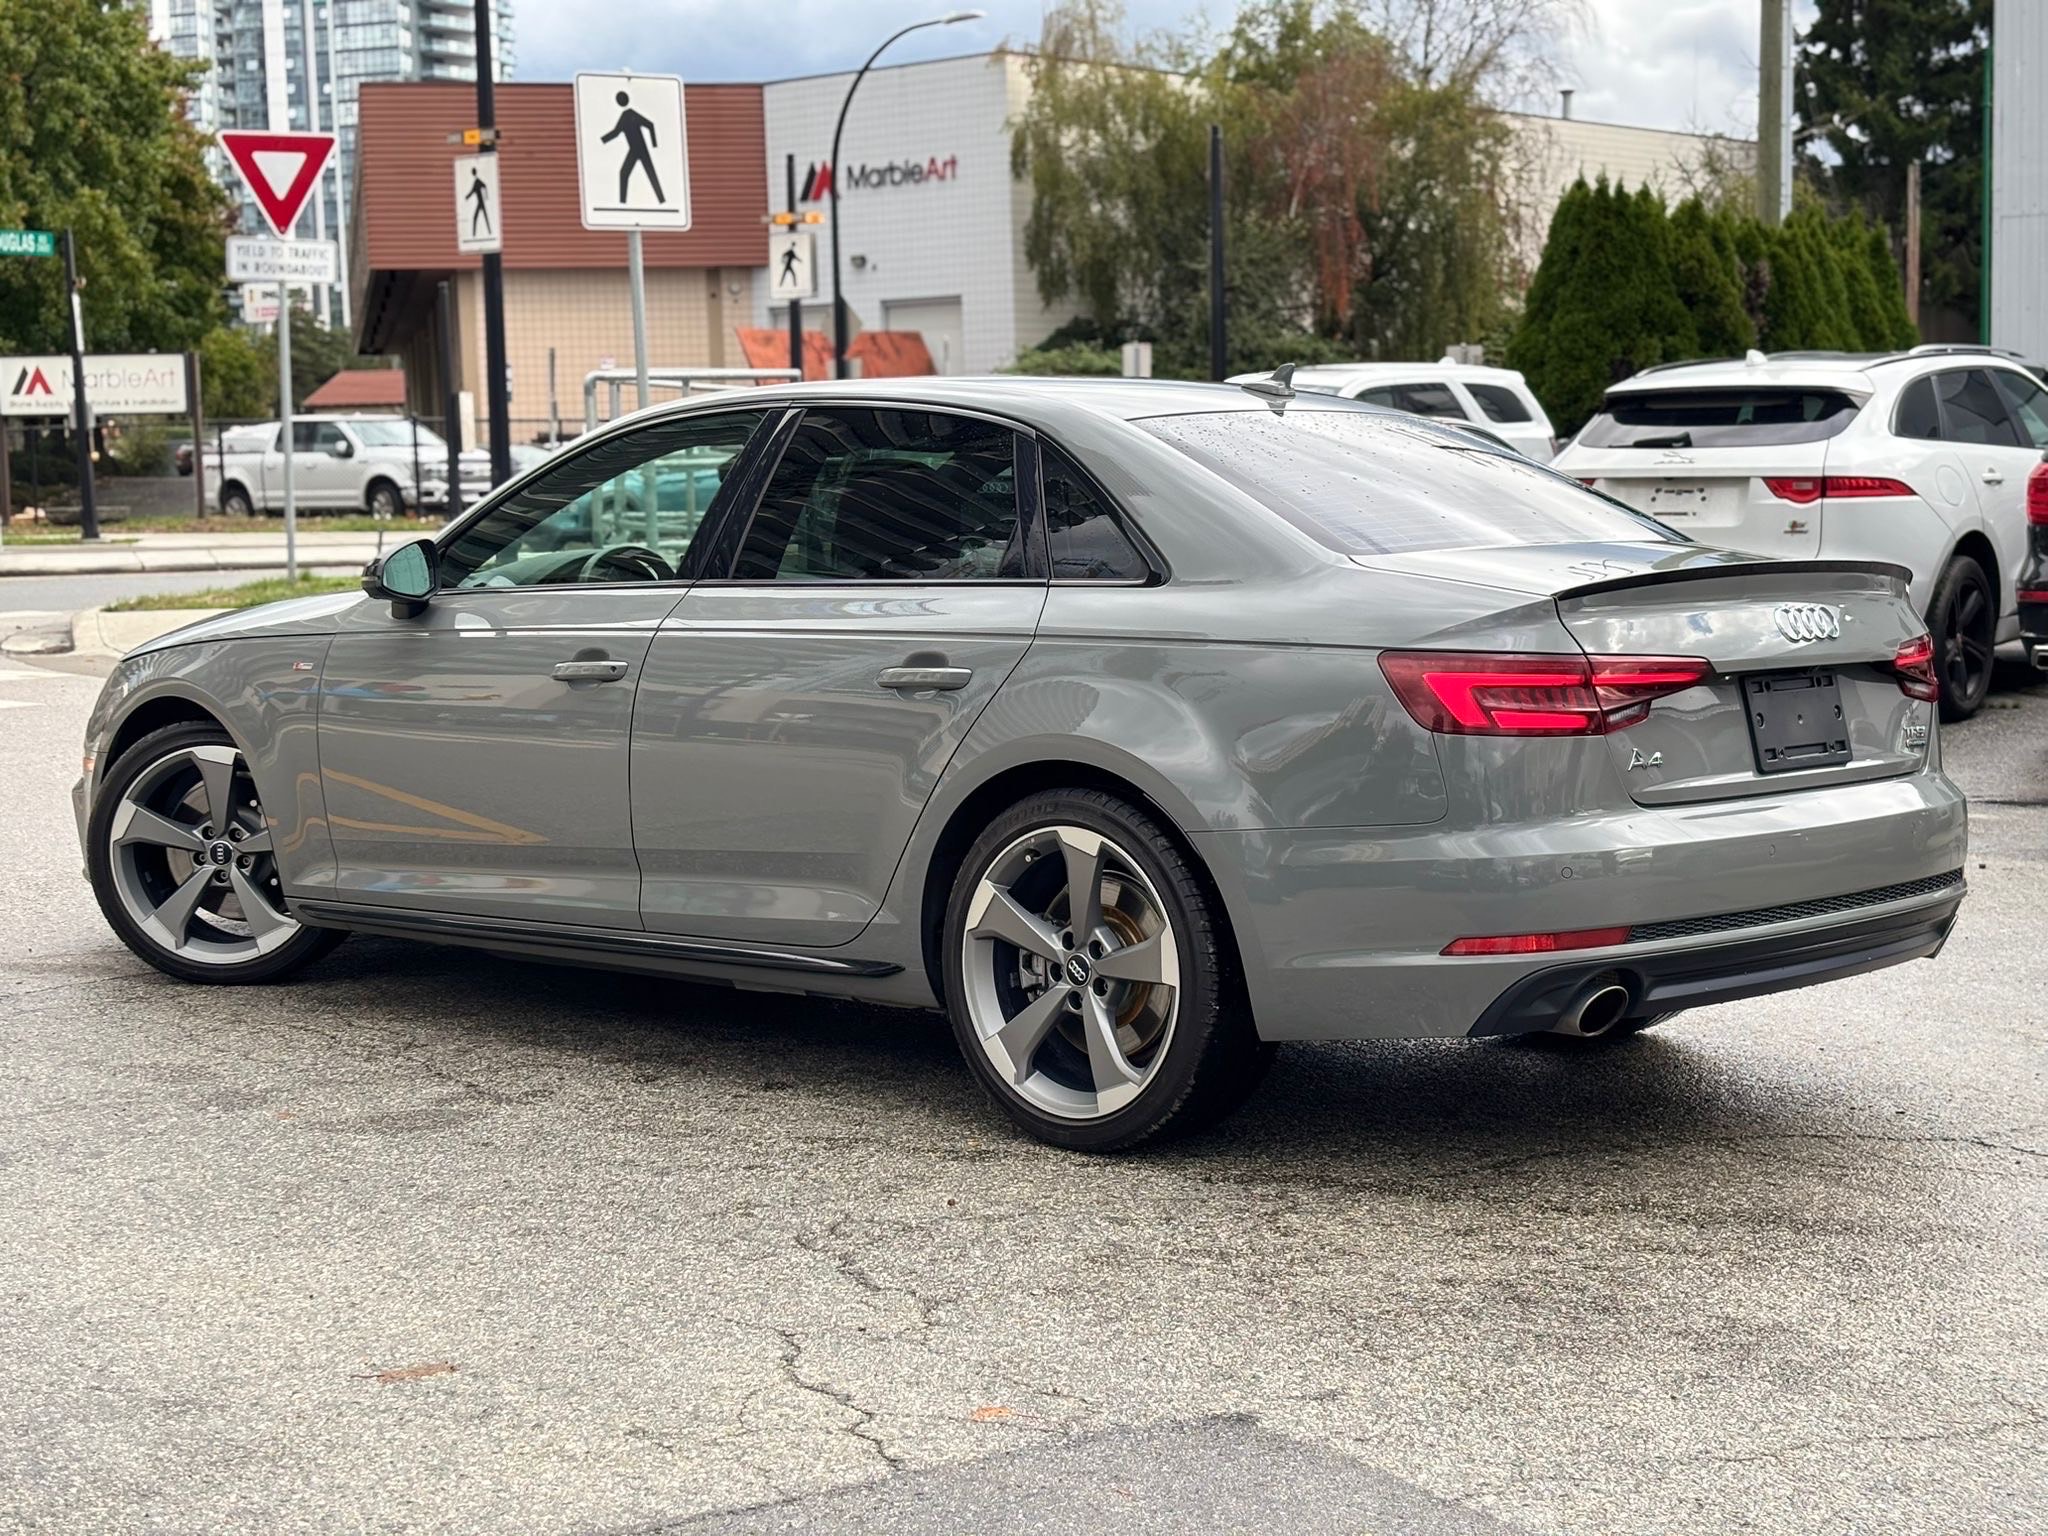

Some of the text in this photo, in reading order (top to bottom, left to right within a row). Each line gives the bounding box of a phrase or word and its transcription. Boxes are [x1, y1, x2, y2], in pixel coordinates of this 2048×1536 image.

[847, 154, 957, 190] MarbleArt
[236, 245, 329, 260] YIELD TO TRAFFIC
[236, 262, 329, 276] IN ROUNDABOUT
[1628, 747, 1663, 771] A4
